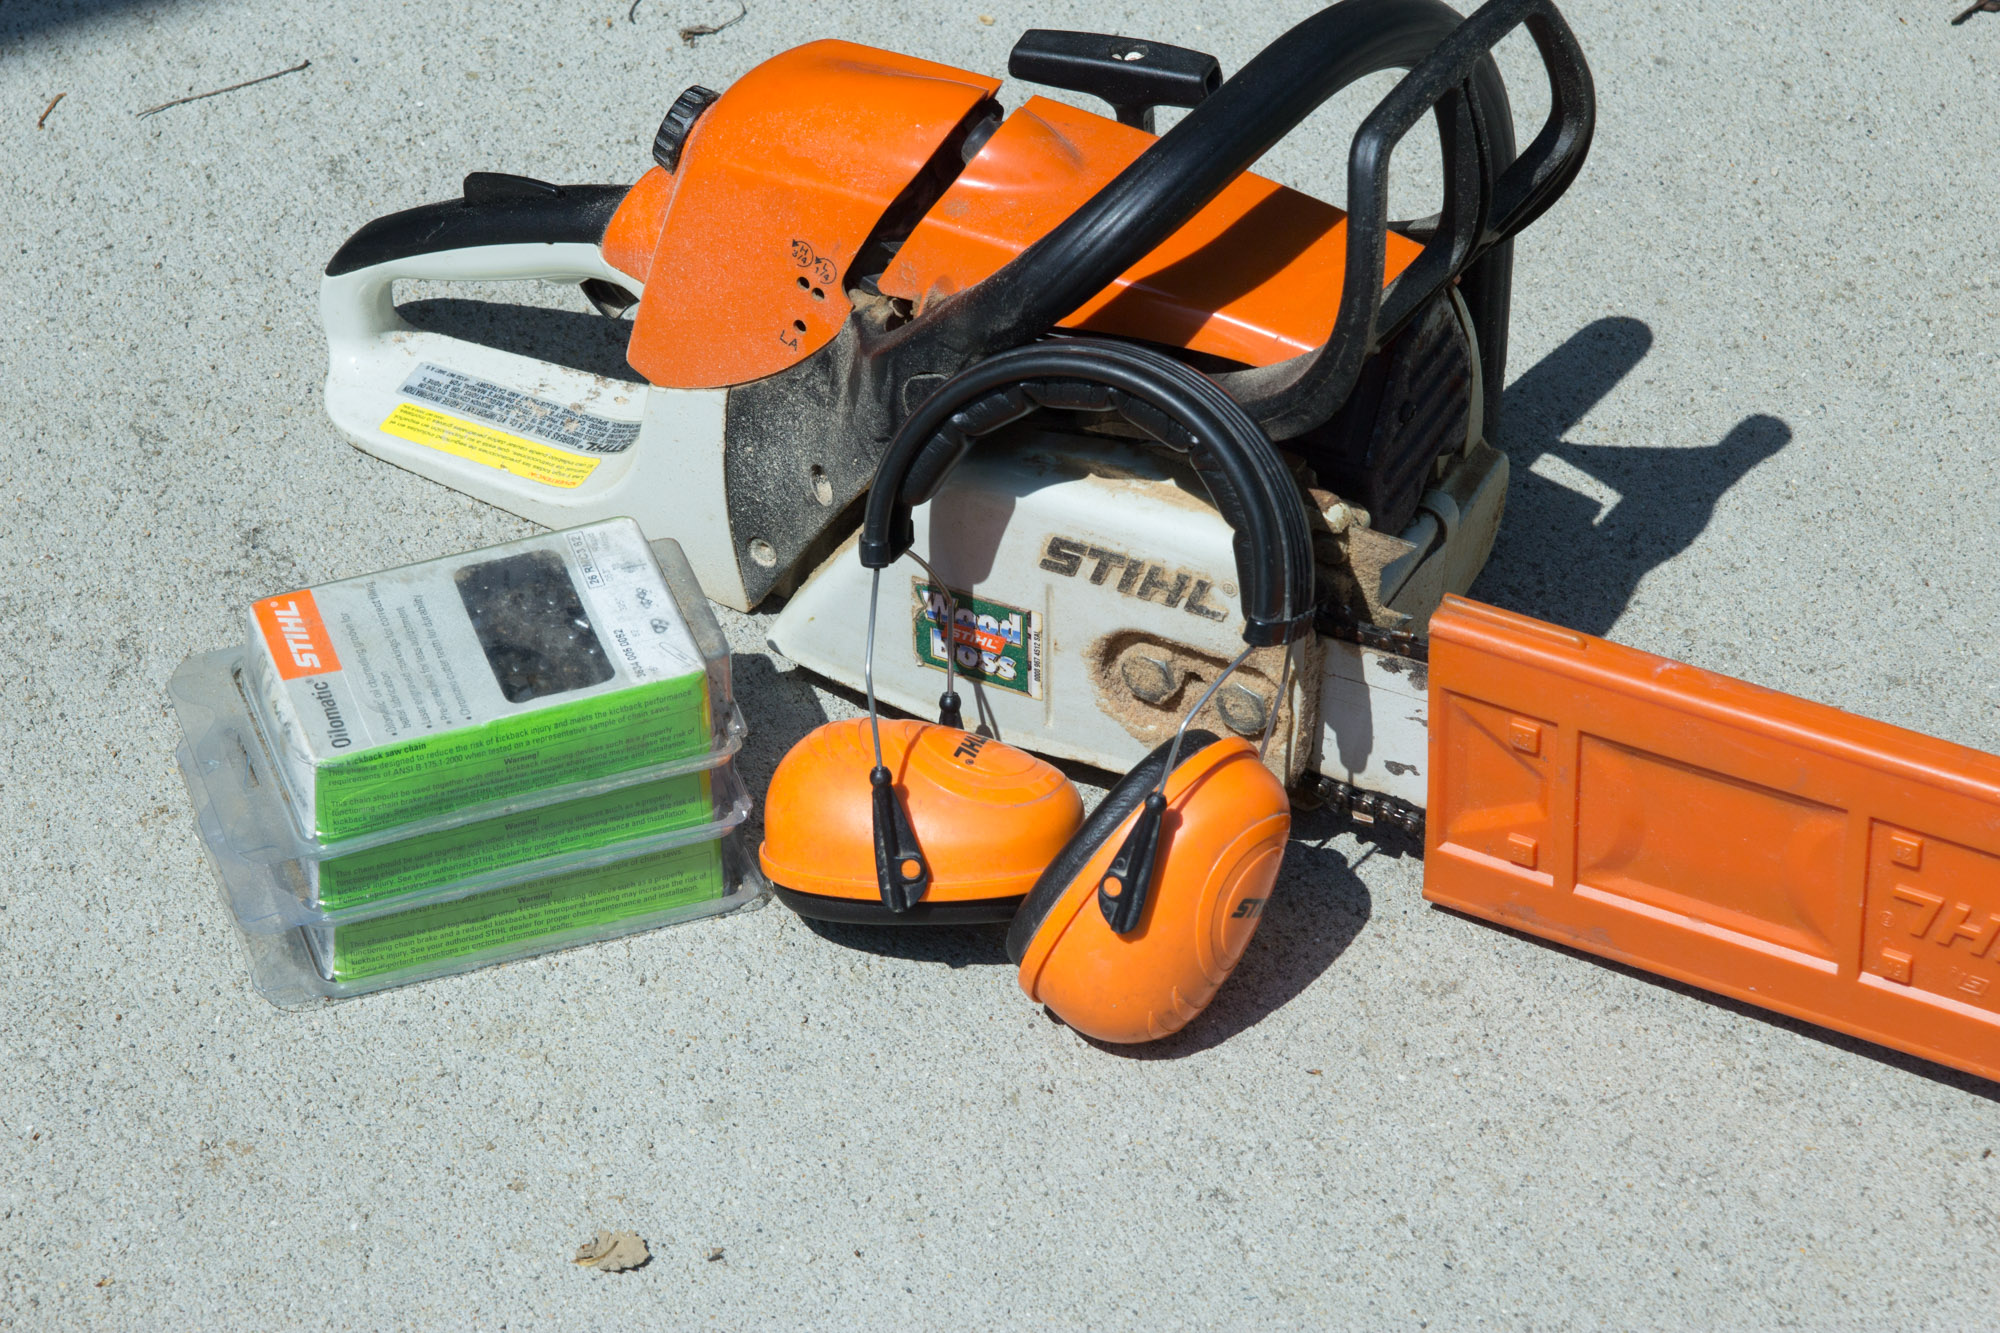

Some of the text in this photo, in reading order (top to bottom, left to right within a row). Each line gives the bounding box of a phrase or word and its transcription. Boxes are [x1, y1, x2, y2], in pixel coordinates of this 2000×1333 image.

[792, 250, 807, 264] 3/4
[800, 246, 808, 255] H
[780, 330, 797, 351] LA
[403, 385, 440, 403] INFORMATION
[463, 405, 496, 418] IMPORTANT
[551, 433, 580, 446] ANDREAS
[586, 574, 600, 585] 26
[1039, 536, 1227, 621] STIHL
[370, 599, 390, 627] correct
[921, 589, 1023, 646] Wood
[274, 600, 321, 667] STIHL
[383, 627, 394, 638] for
[952, 629, 998, 650] STIHL
[388, 638, 408, 671] markings
[629, 661, 646, 678] 3634
[400, 671, 423, 704] engraved
[312, 681, 351, 747] Oilomatic
[417, 706, 431, 724] Laser
[379, 755, 414, 769] designed
[426, 748, 453, 758] reduce
[455, 744, 467, 752] the
[470, 739, 482, 748] risk
[486, 736, 493, 745] of
[495, 728, 527, 742] kickback
[530, 724, 551, 734] injury
[554, 718, 567, 728] and
[570, 713, 592, 724] meets
[594, 710, 606, 718] the
[609, 700, 641, 714] kickback
[644, 689, 691, 707] performance
[329, 771, 380, 786] requirements
[393, 764, 413, 775] ANSI
[465, 750, 485, 759] when
[488, 743, 511, 754] tested
[532, 726, 587, 744] representative
[589, 718, 615, 730] sample
[617, 714, 625, 722] of
[627, 710, 647, 720] chain
[385, 749, 399, 757] saw
[403, 742, 426, 753] chain
[503, 751, 539, 765] Warning!
[517, 890, 552, 904] Warning!
[350, 940, 364, 948] This
[368, 936, 387, 944] chain
[390, 929, 413, 940] should
[427, 922, 444, 932] used
[447, 916, 477, 927] together
[480, 911, 495, 920] with
[498, 908, 516, 916] other
[519, 899, 551, 911] kickback
[553, 893, 585, 904] reducing
[588, 886, 615, 896] devices
[617, 880, 635, 889] such
[654, 870, 683, 883] properly
[351, 944, 392, 957] functioning
[394, 939, 414, 948] chain
[416, 934, 437, 943] brake
[439, 929, 453, 938] and
[462, 921, 491, 933] reduced
[494, 913, 526, 926] kickback
[544, 904, 576, 915] Improper
[579, 894, 619, 907] sharpening
[621, 890, 636, 898] may
[638, 883, 669, 894] increase
[684, 874, 697, 883] risk
[351, 953, 384, 966] kickback
[427, 942, 442, 951] your
[445, 932, 483, 946] authorized
[485, 927, 506, 937] STIHL
[509, 923, 531, 932] dealer
[546, 914, 569, 925] proper
[572, 909, 592, 918] chain
[594, 898, 641, 913] maintenance
[643, 893, 656, 902] and
[415, 948, 458, 961] instructions
[472, 936, 504, 949] enclosed
[506, 928, 547, 941] information
